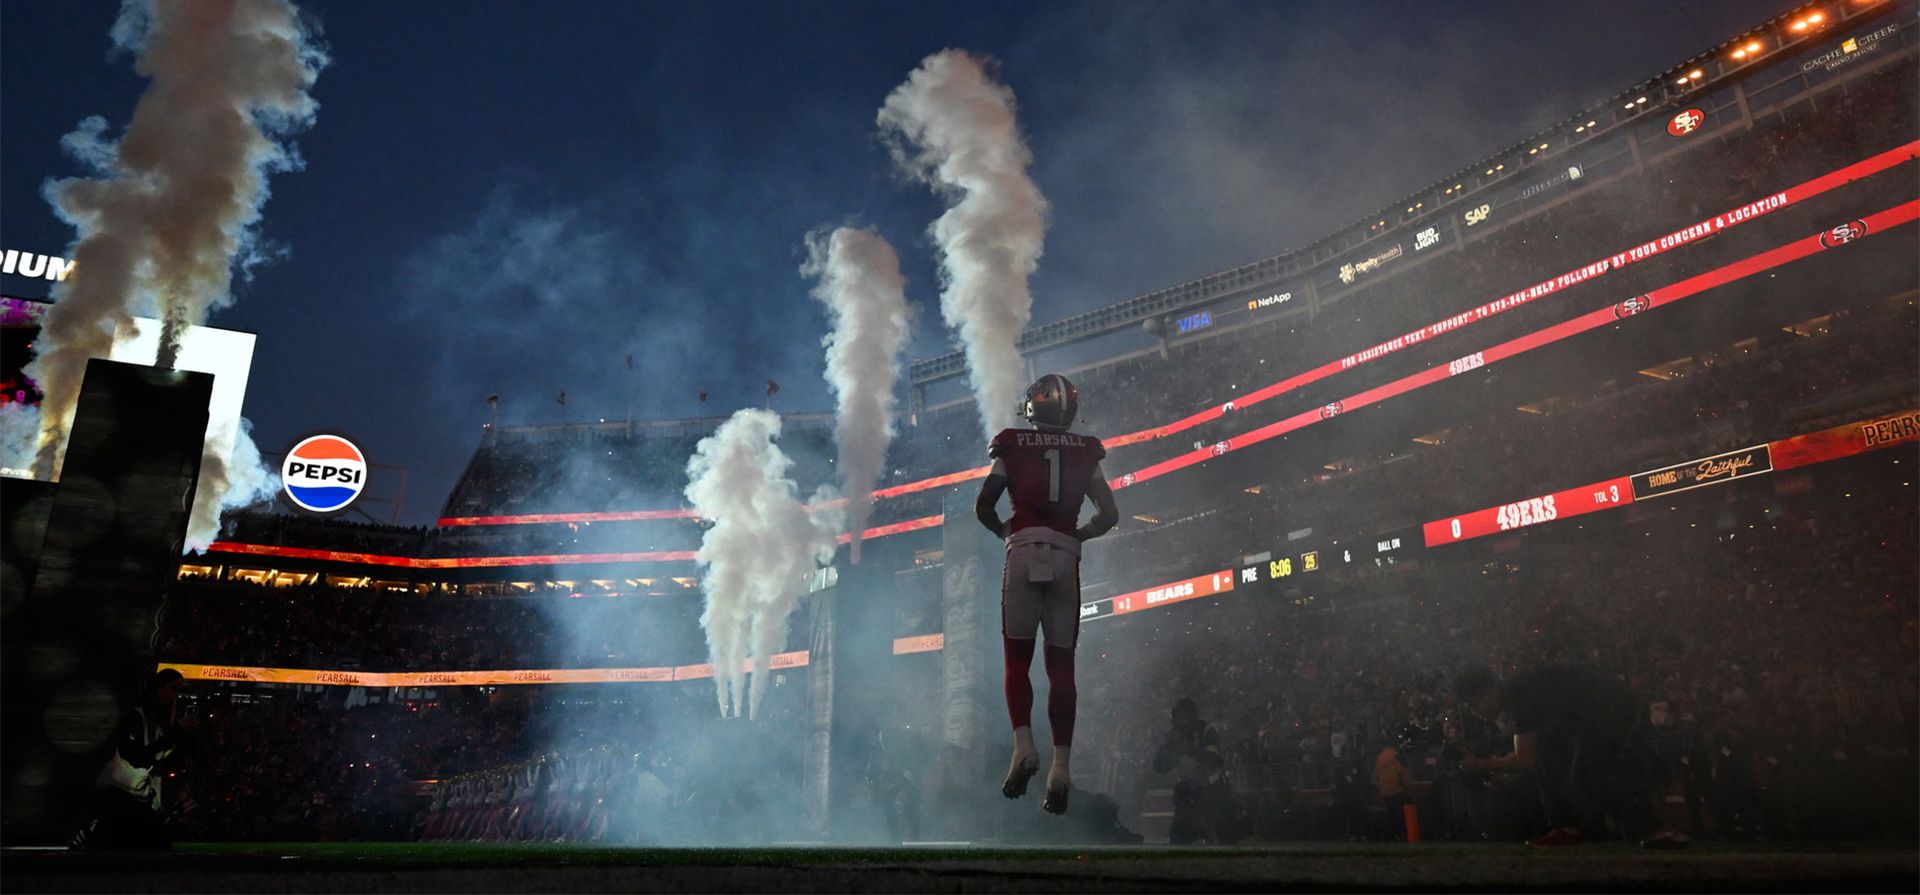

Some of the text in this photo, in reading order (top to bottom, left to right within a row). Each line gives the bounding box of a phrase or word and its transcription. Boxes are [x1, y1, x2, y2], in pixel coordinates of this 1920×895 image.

[1803, 23, 1897, 71] CACHE CREEK
[1464, 204, 1490, 226] SAP
[1415, 232, 1440, 250] LIGHT
[1416, 227, 1435, 241] BUD
[0, 249, 78, 281] IUM
[1358, 337, 1403, 362] ASSISTANCE
[1405, 329, 1426, 345] TEXT
[1476, 306, 1488, 319] TO
[1613, 253, 1626, 268] BY
[1629, 242, 1658, 261] YOUR
[1660, 222, 1712, 249] CONCERN
[1715, 216, 1725, 229] &
[1727, 192, 1788, 225] LOCATION
[1257, 292, 1292, 307] NetApp
[1177, 311, 1212, 332] VISA
[1449, 351, 1485, 376] 49ERS
[1016, 432, 1085, 447] PEARSALL
[288, 461, 361, 484] PEPSI
[1044, 448, 1061, 502] 1
[1648, 470, 1677, 488] HOME
[1451, 485, 1620, 538] 0 49ERS TOL 3
[1241, 567, 1258, 583] PRE
[1269, 557, 1291, 578] 8:06
[1304, 554, 1315, 569] 25
[1146, 582, 1194, 605] BEARS
[1212, 574, 1221, 592] 0
[202, 667, 249, 679] PEARSALL
[316, 673, 360, 684] PEARSALL
[419, 674, 457, 683] PEARSALL
[513, 672, 552, 681] PEARSALL
